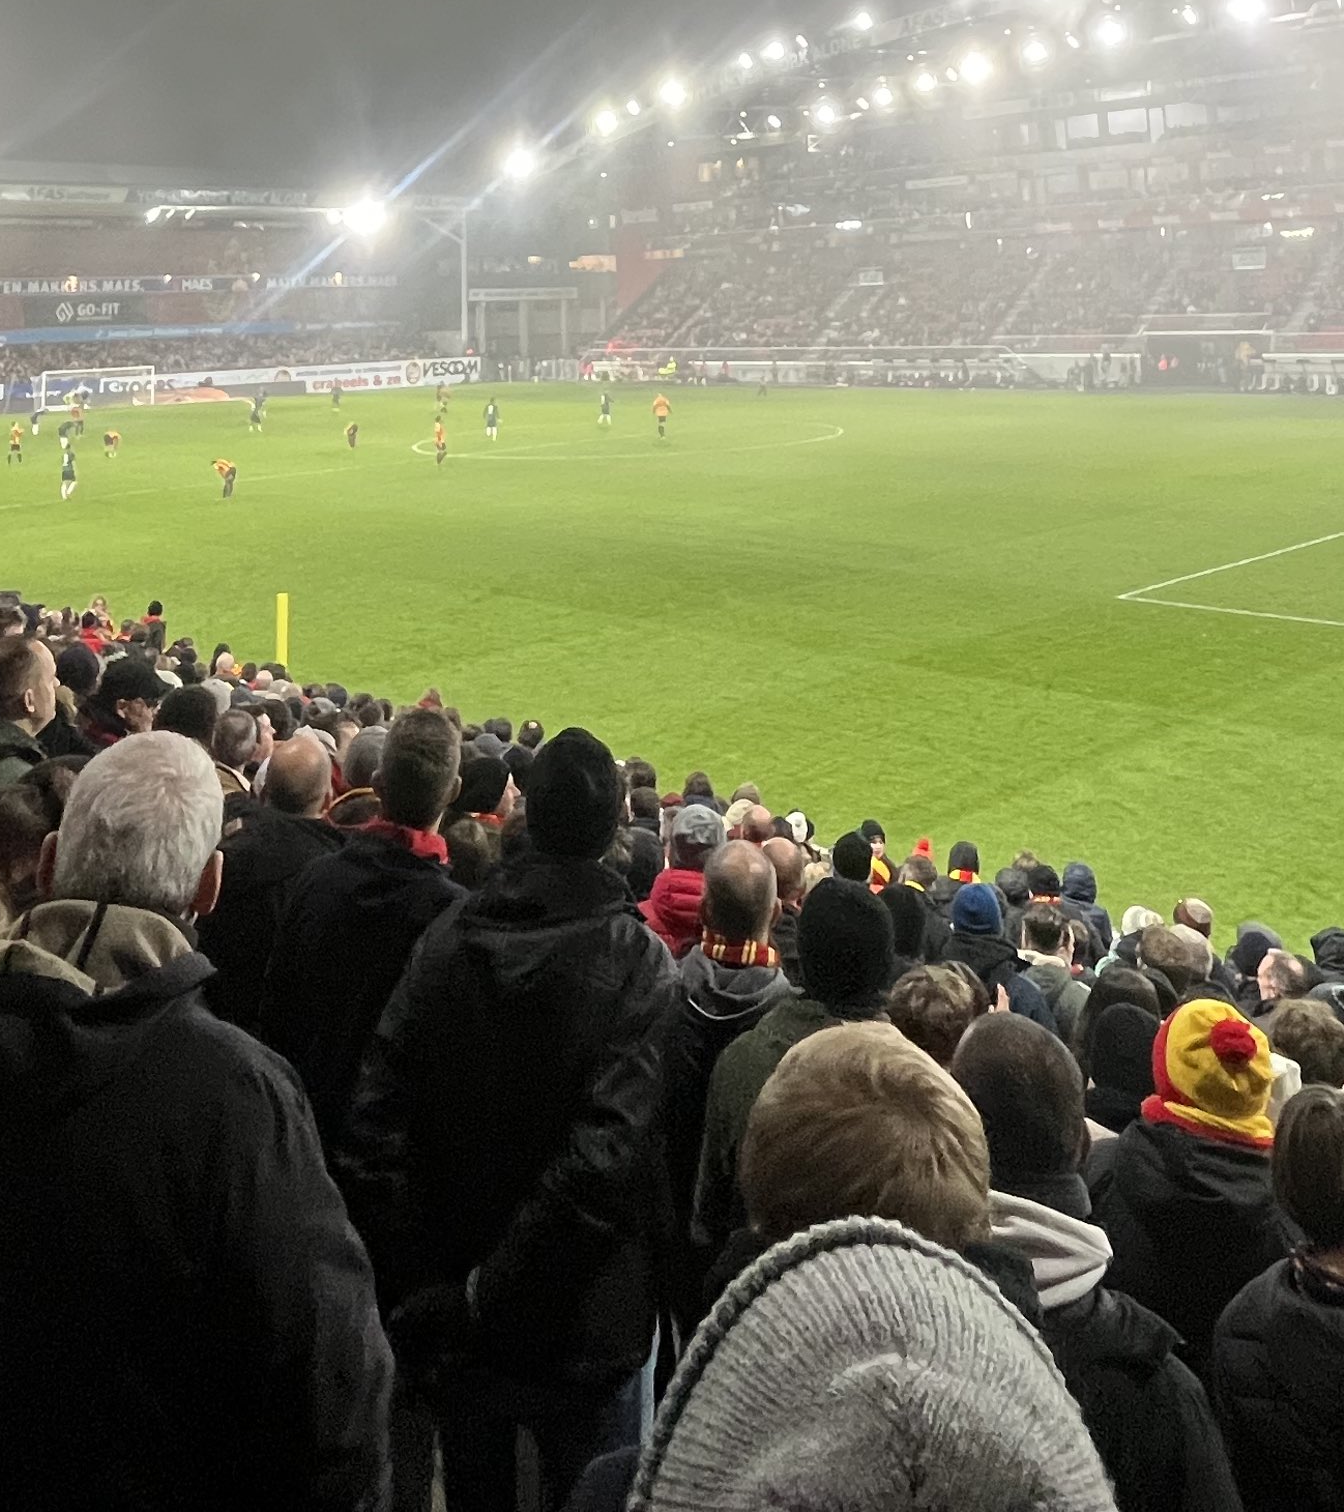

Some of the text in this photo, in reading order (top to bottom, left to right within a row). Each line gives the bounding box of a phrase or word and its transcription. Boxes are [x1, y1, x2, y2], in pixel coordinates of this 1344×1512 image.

[182, 278, 213, 290] MAES
[77, 302, 120, 316] GO-FIT
[423, 359, 478, 378] VESCOM
